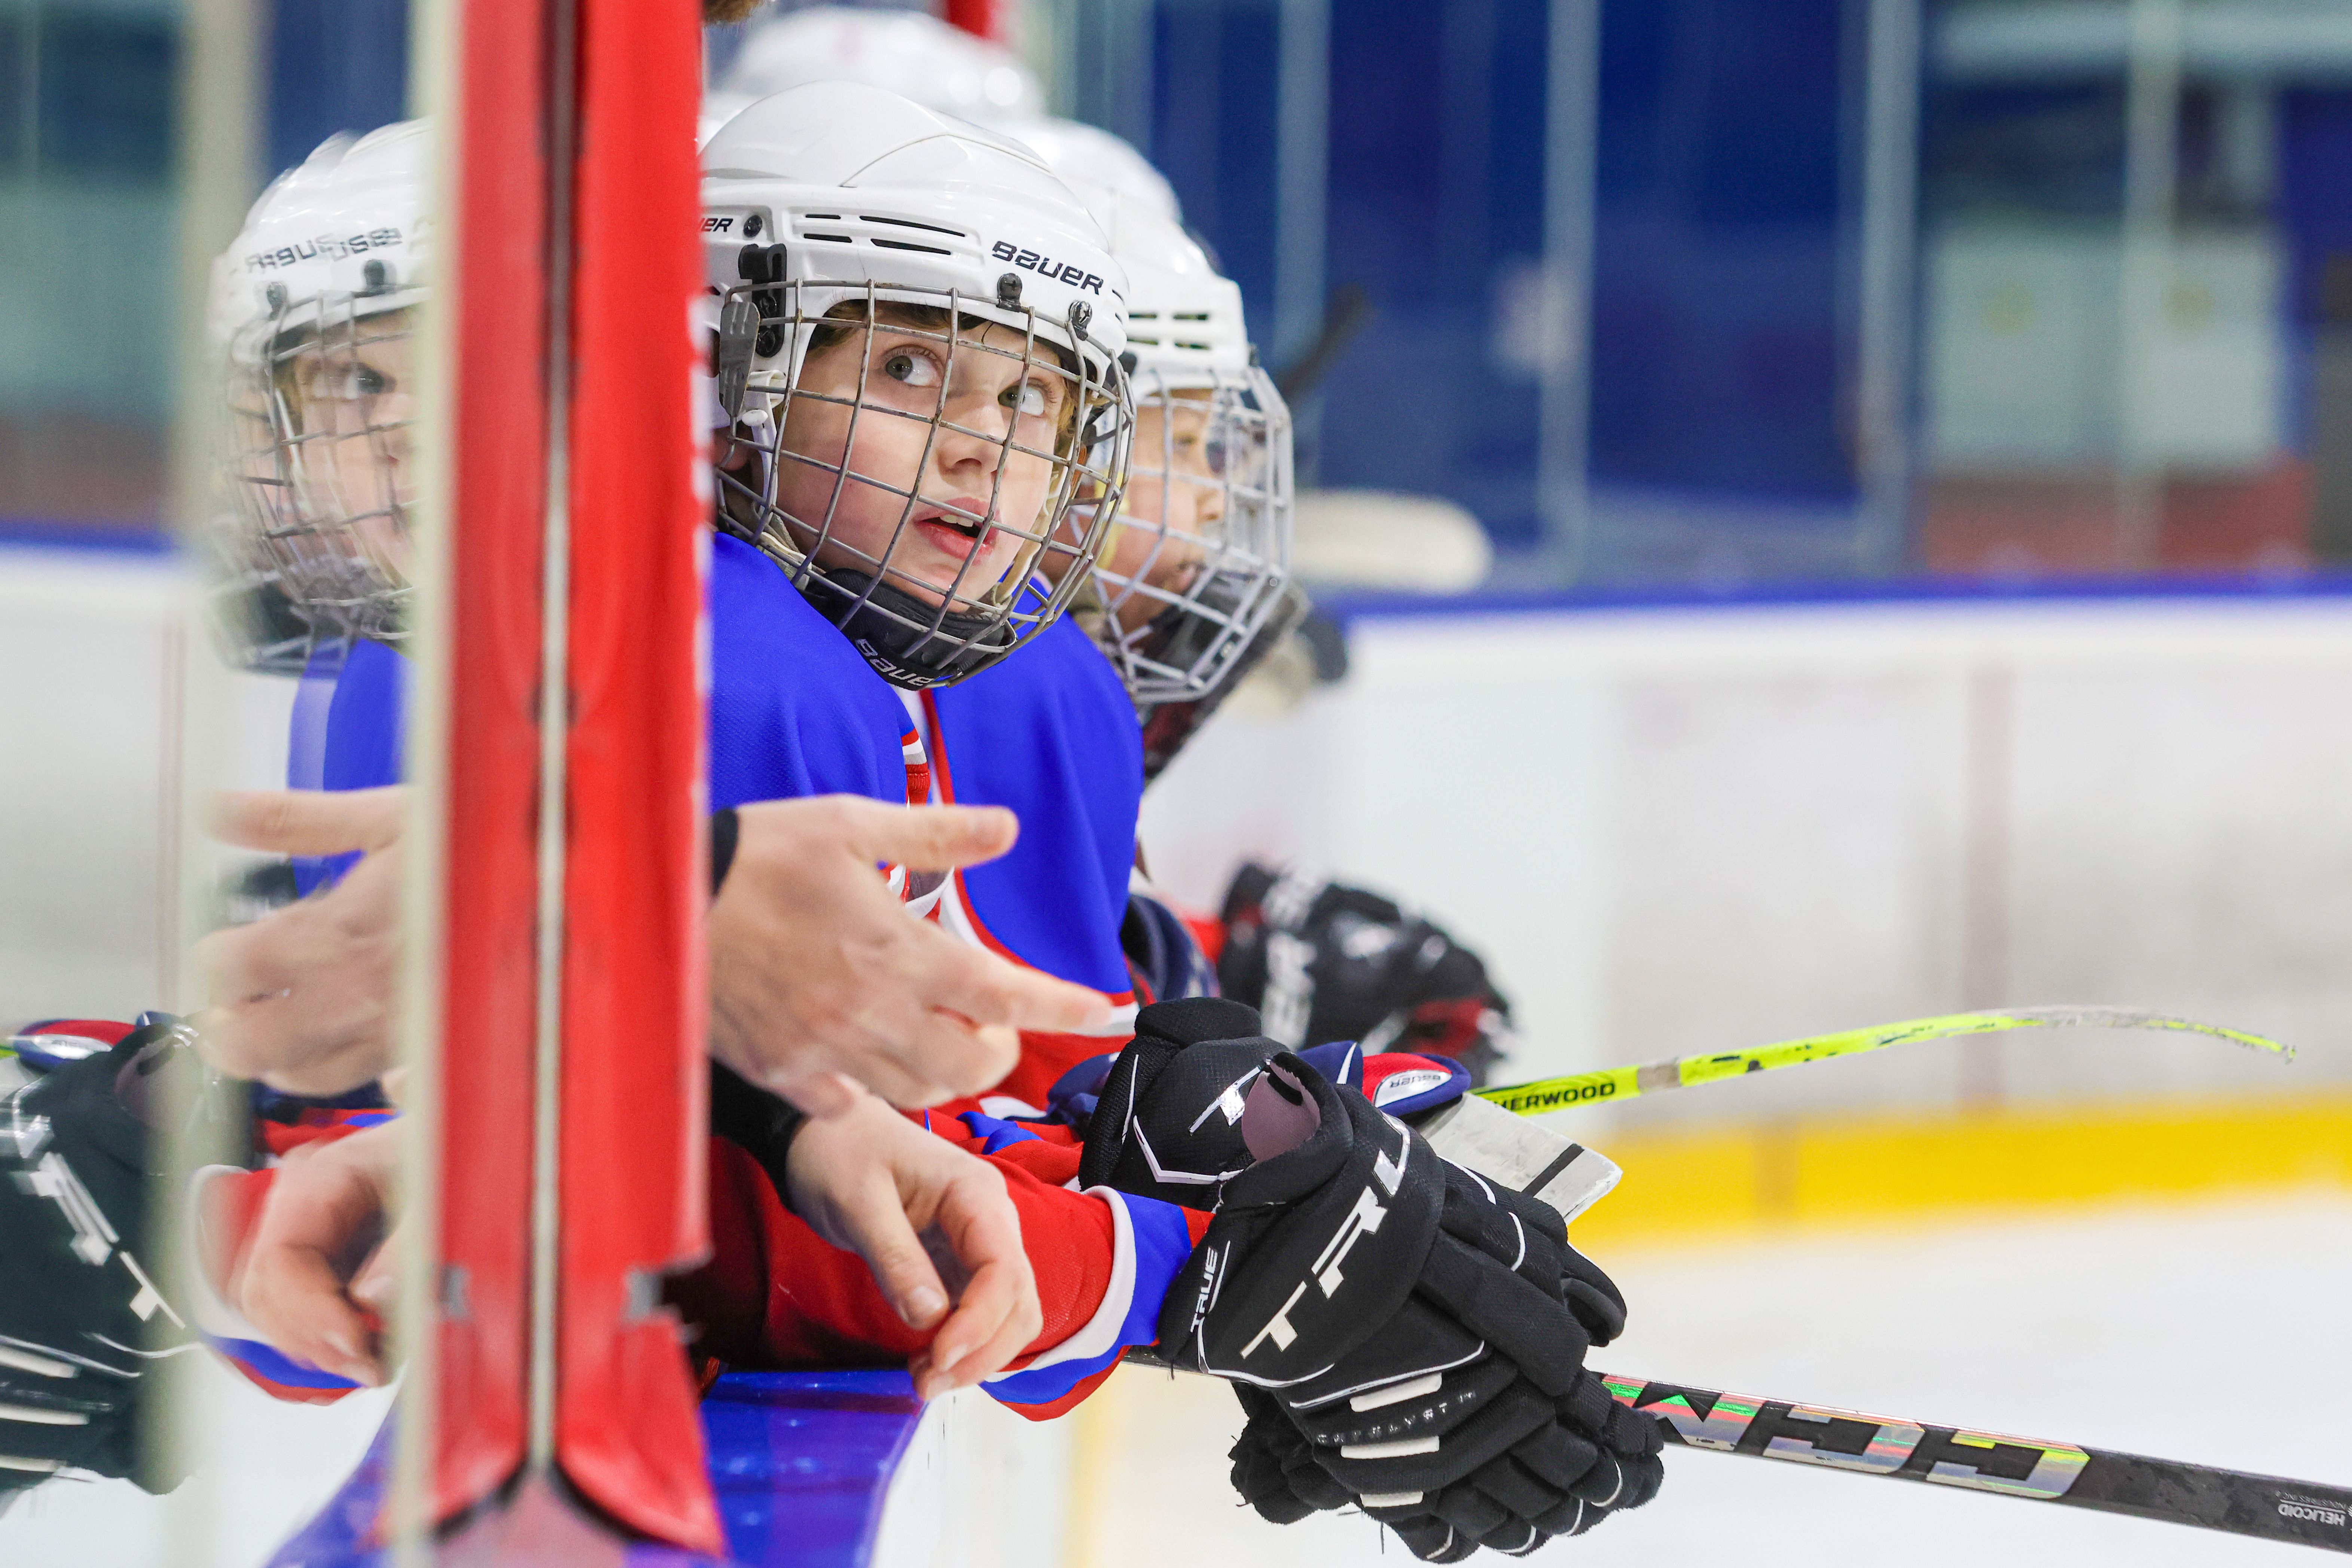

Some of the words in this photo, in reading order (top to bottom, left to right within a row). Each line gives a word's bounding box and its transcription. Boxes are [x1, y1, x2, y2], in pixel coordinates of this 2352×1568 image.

[992, 241, 1104, 295] BAUER
[1190, 1246, 1218, 1333] TRUE
[2278, 1503, 2346, 1526] HELICOID
